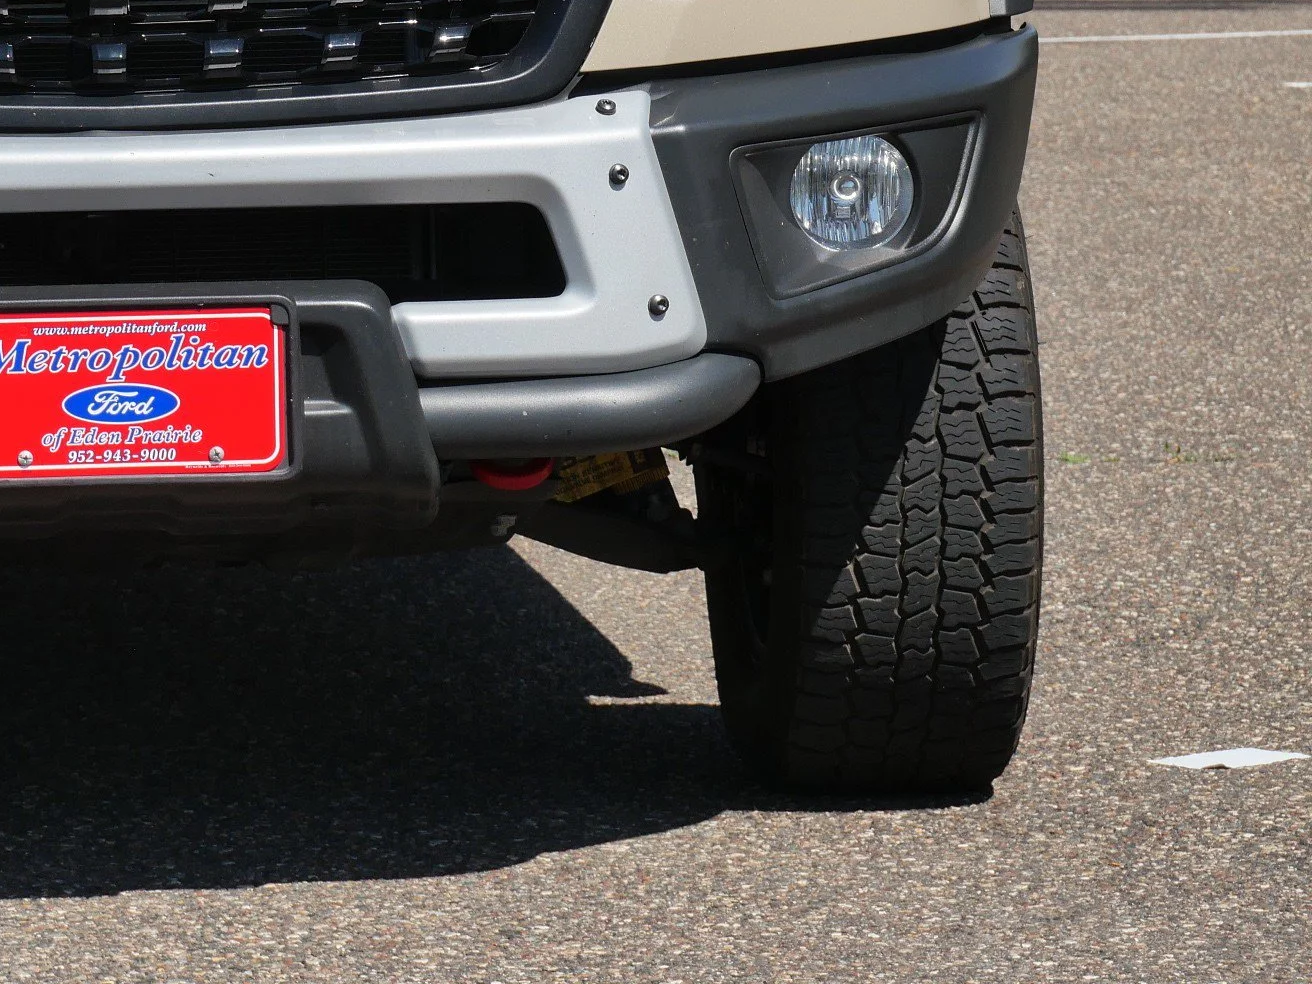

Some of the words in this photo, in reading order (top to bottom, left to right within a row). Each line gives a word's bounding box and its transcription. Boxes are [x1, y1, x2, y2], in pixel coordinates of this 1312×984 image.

[33, 321, 207, 338] www.metropolitanford.com
[87, 390, 154, 416] Ford
[41, 427, 67, 452] of
[67, 427, 122, 447] Eden
[125, 424, 203, 445] Prairie
[68, 447, 177, 464] 952-943-9000
